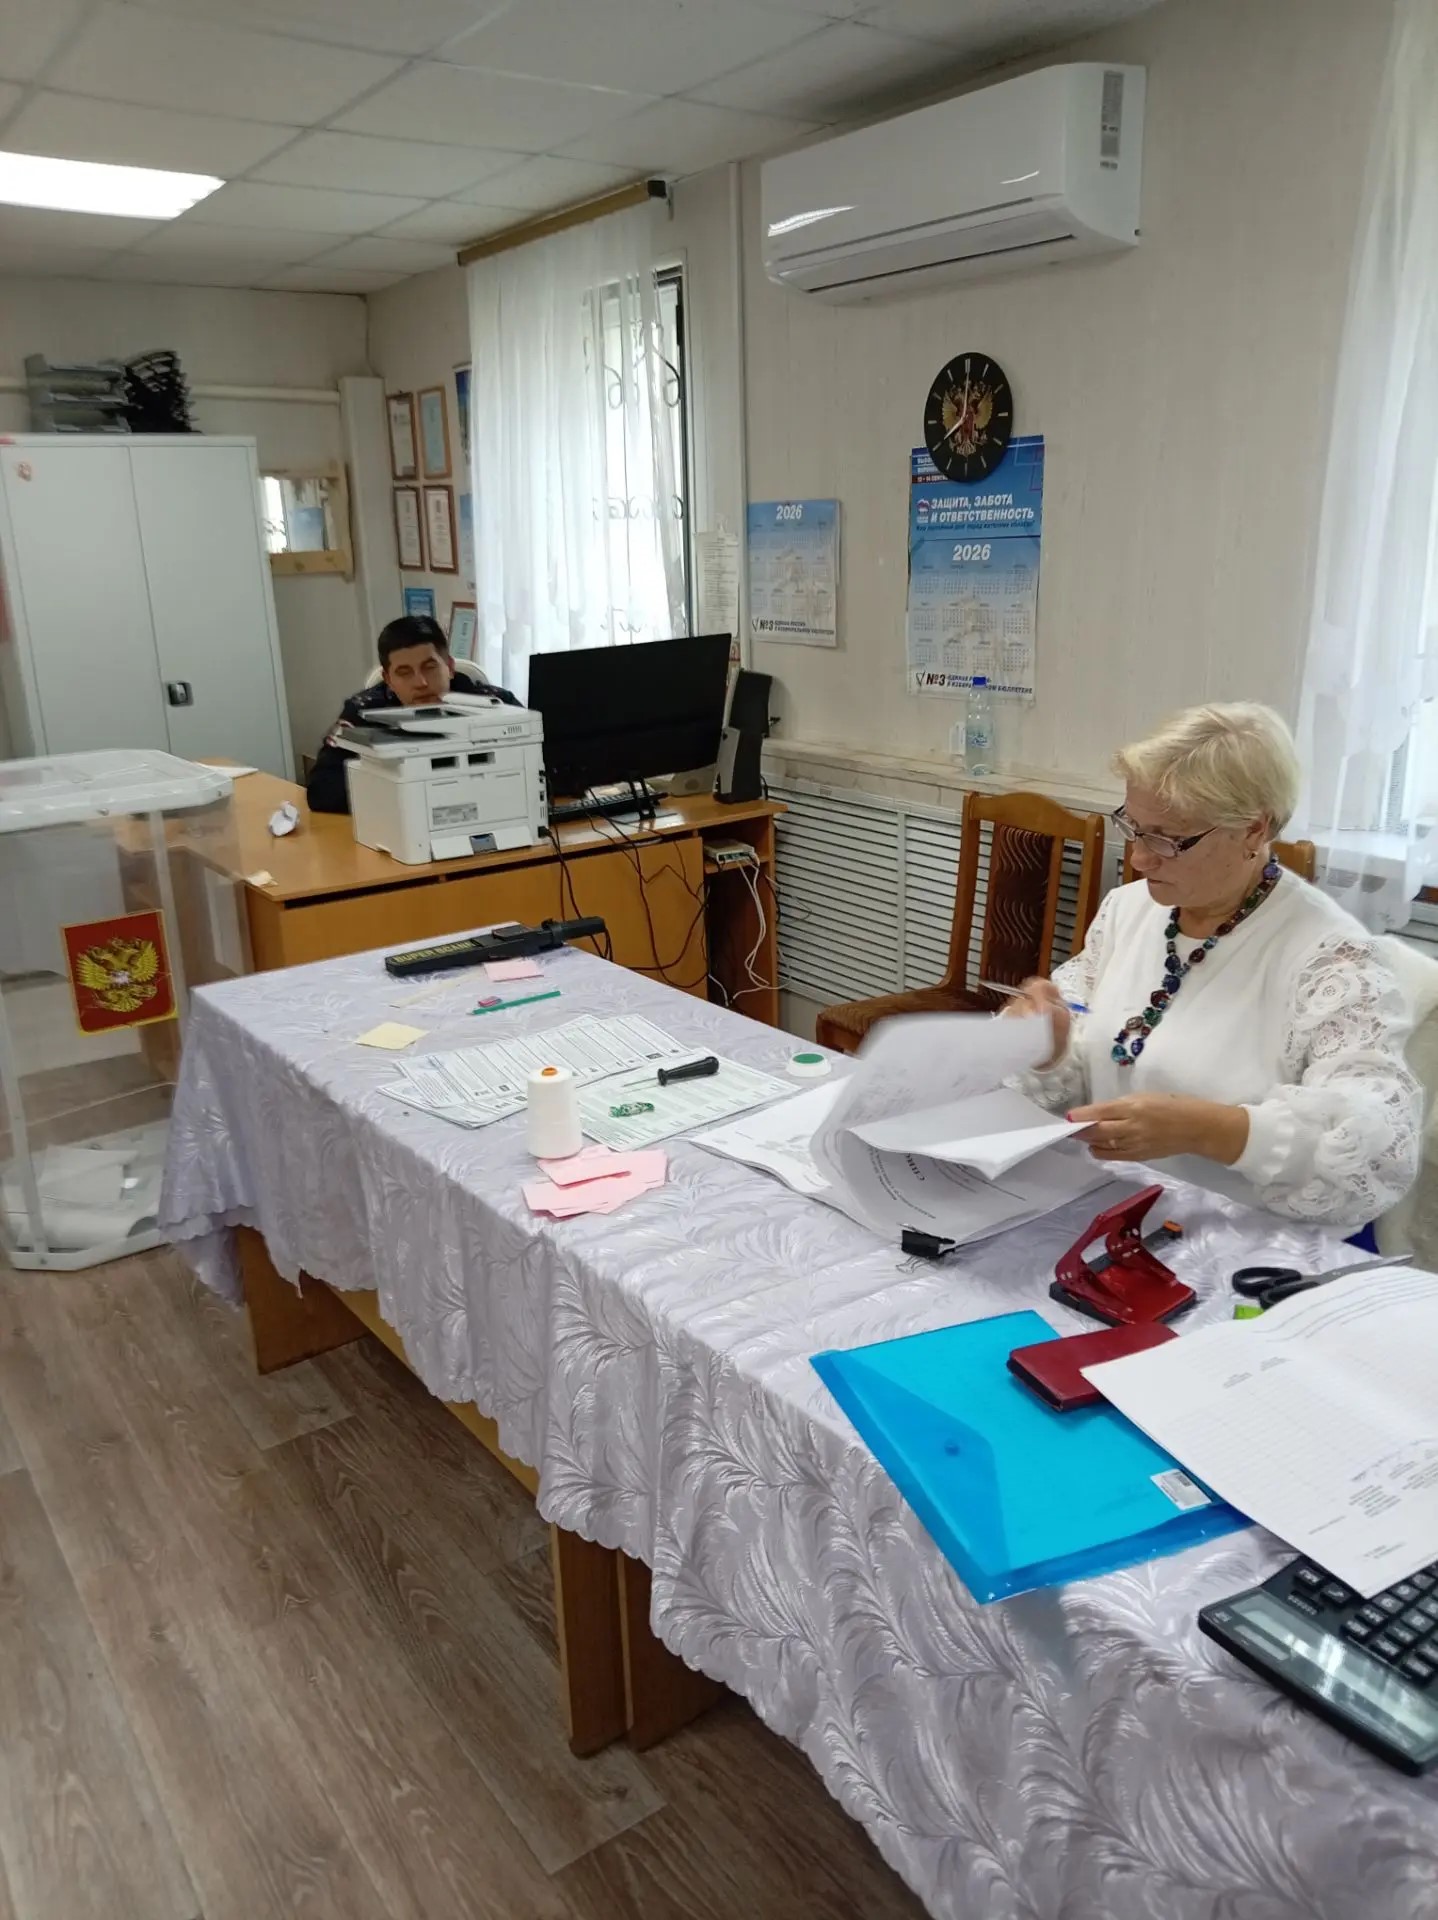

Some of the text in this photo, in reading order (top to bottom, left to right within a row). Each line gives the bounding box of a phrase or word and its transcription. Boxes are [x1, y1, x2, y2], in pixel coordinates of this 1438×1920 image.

[931, 494, 1013, 510] ЗАЩИТА, ЗАБОТА
[776, 504, 802, 520] 2026
[931, 512, 938, 523] И
[939, 507, 1035, 522] ОТВЕТСТВЕННОСТЬ
[953, 544, 991, 561] 2026
[926, 673, 946, 686] №3
